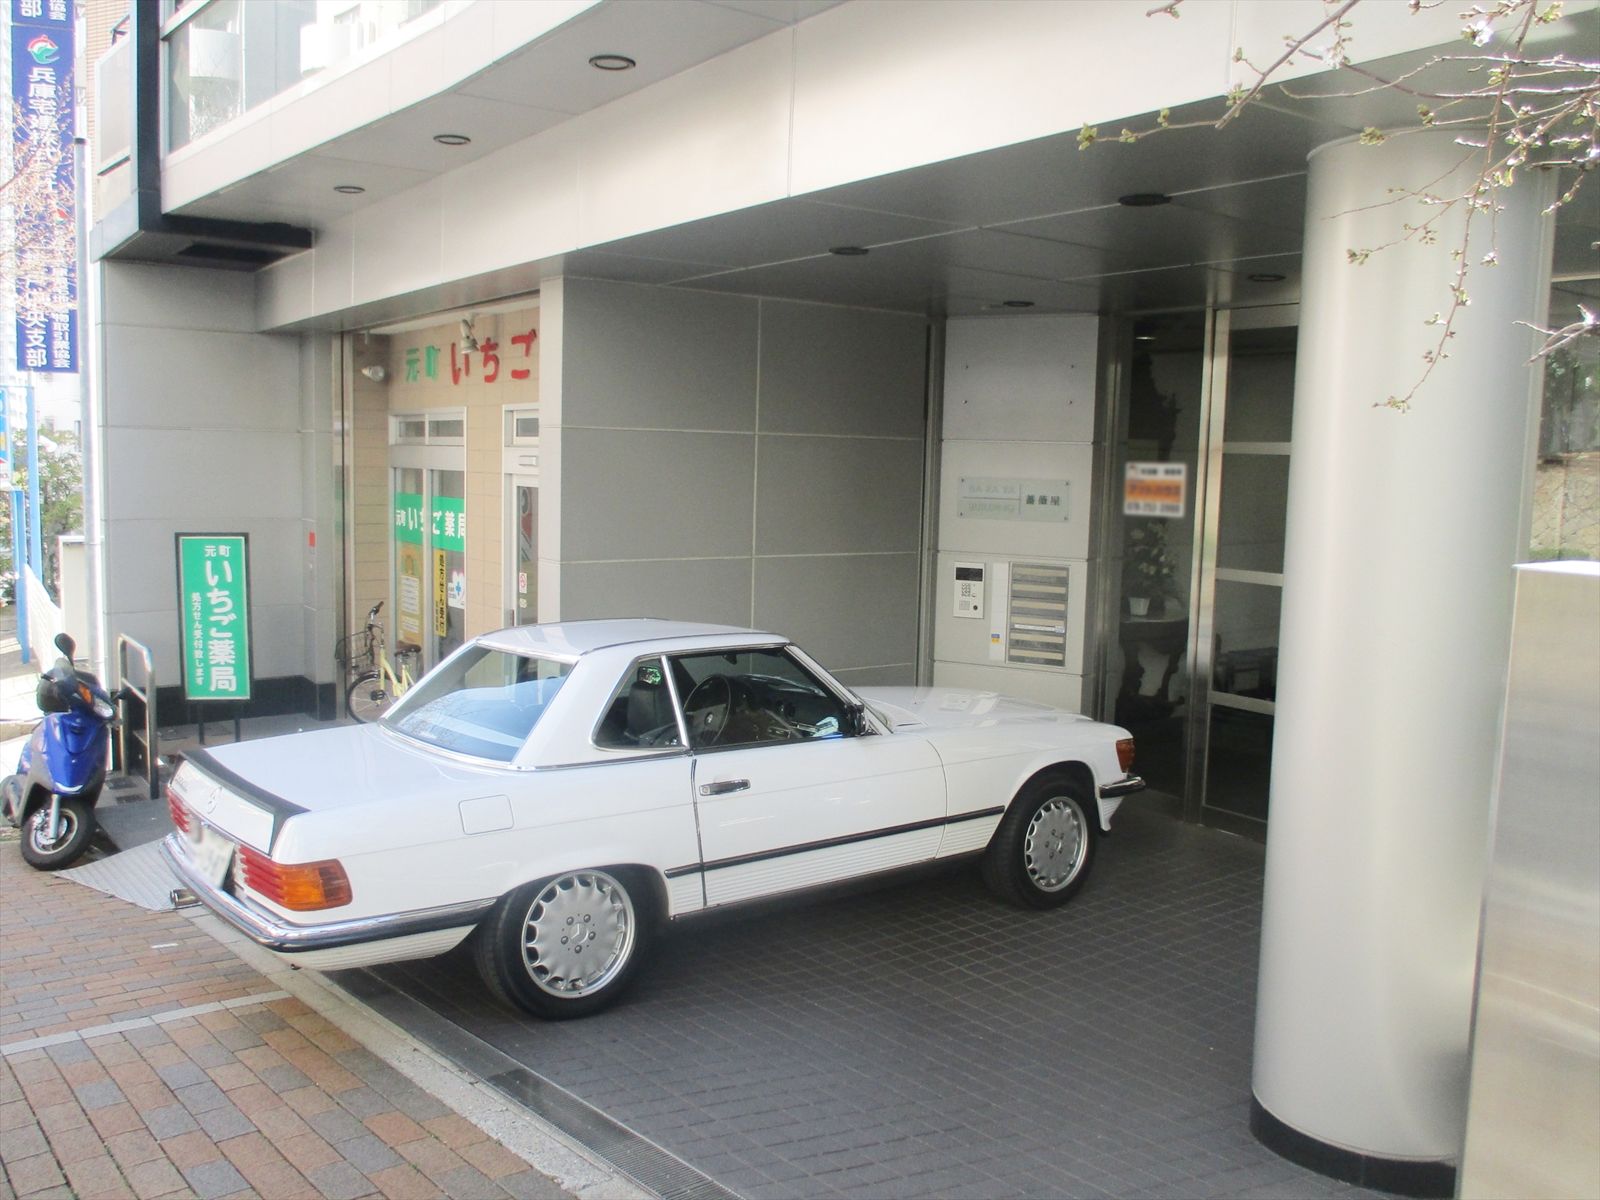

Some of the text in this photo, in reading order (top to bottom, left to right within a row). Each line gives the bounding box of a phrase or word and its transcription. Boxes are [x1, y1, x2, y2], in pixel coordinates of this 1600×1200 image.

[205, 560, 237, 691] いちご薬局
